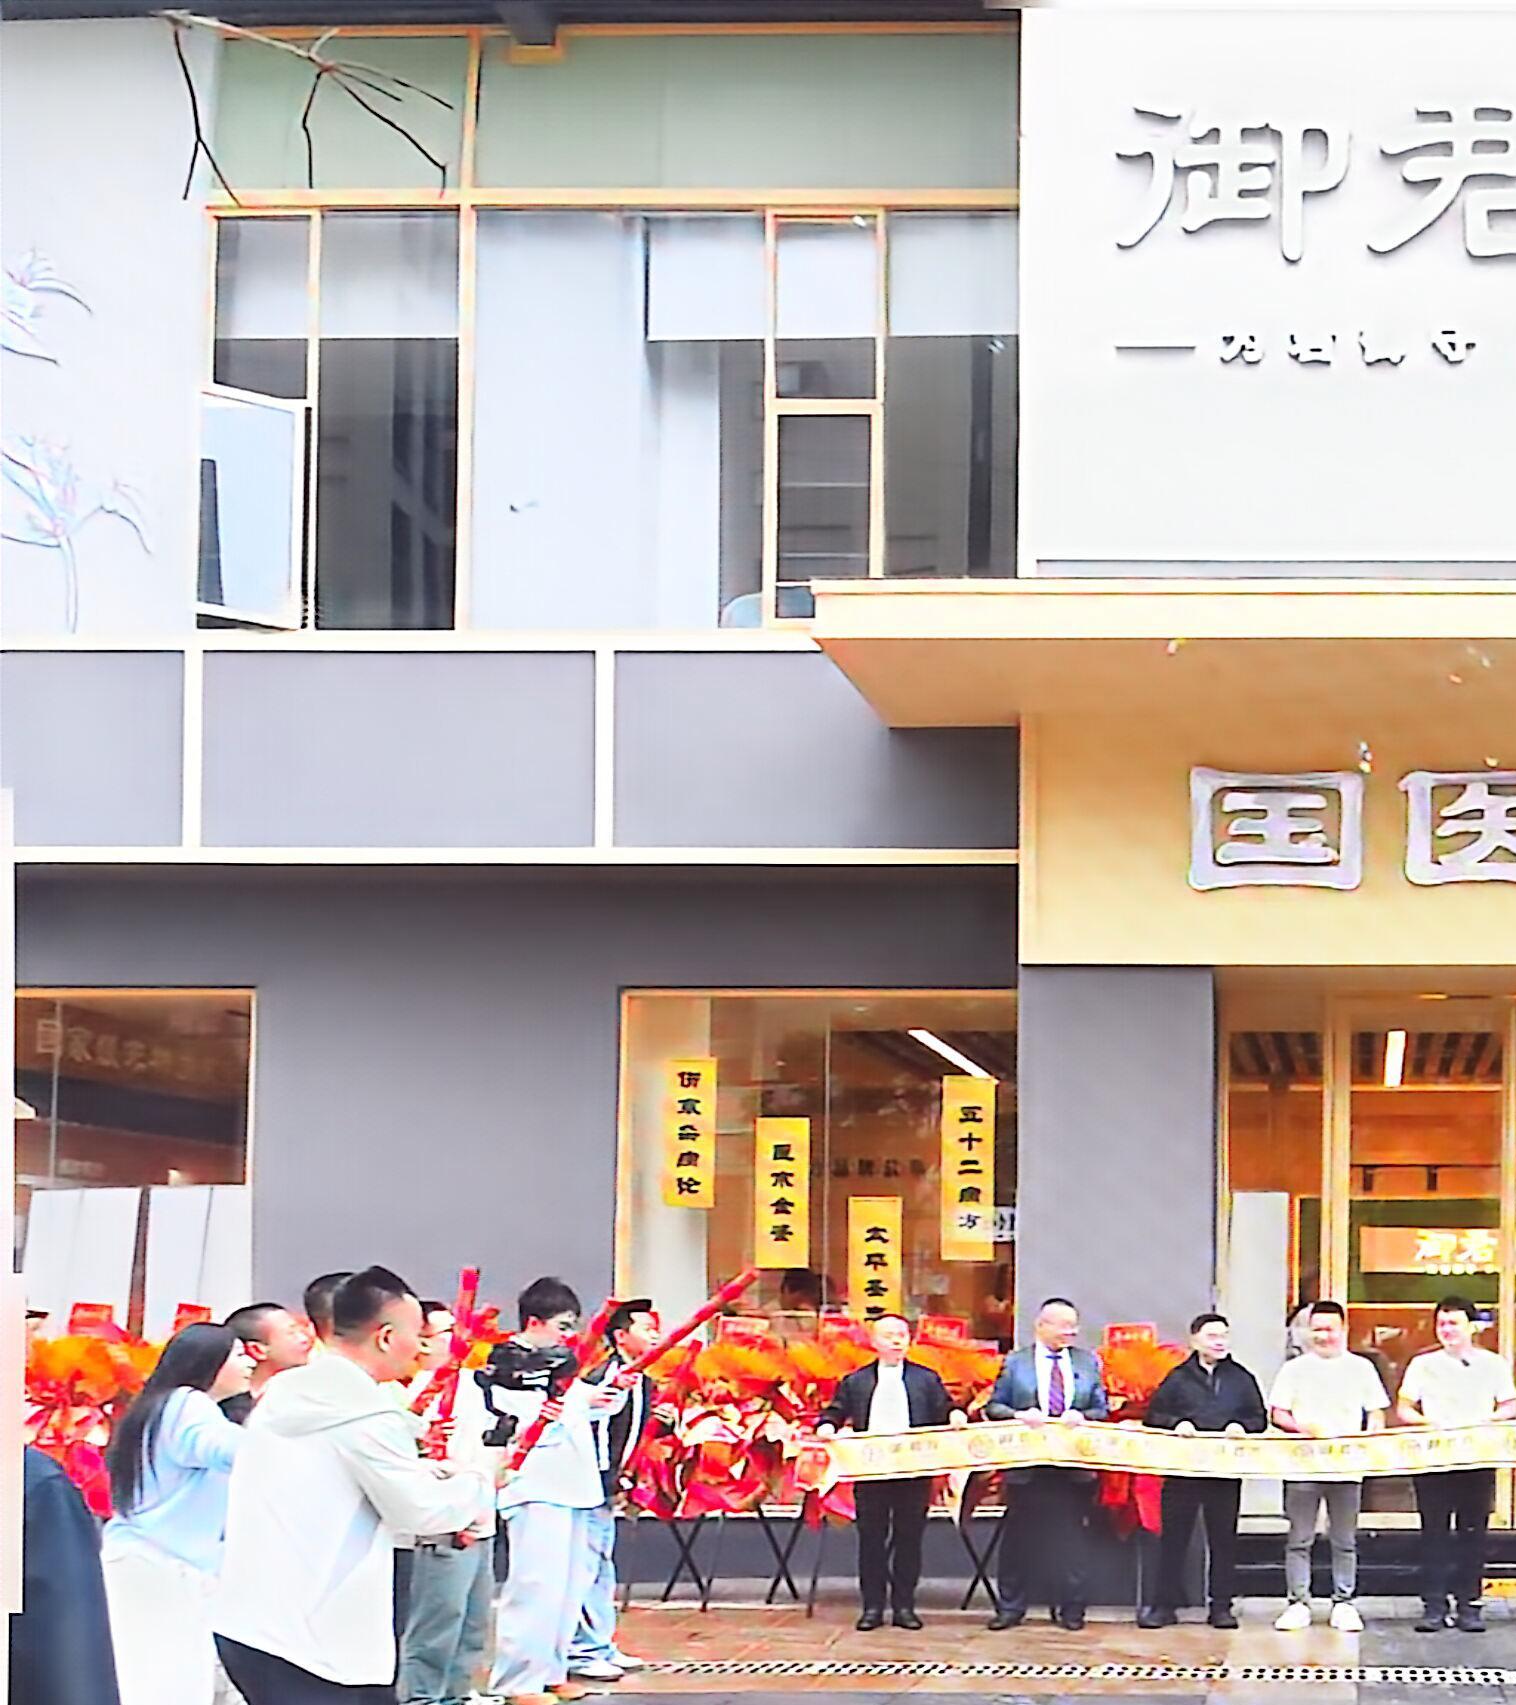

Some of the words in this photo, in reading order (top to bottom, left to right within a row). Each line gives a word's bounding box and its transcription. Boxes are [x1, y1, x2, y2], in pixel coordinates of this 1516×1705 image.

[957, 1105, 984, 1230] 五十二病方
